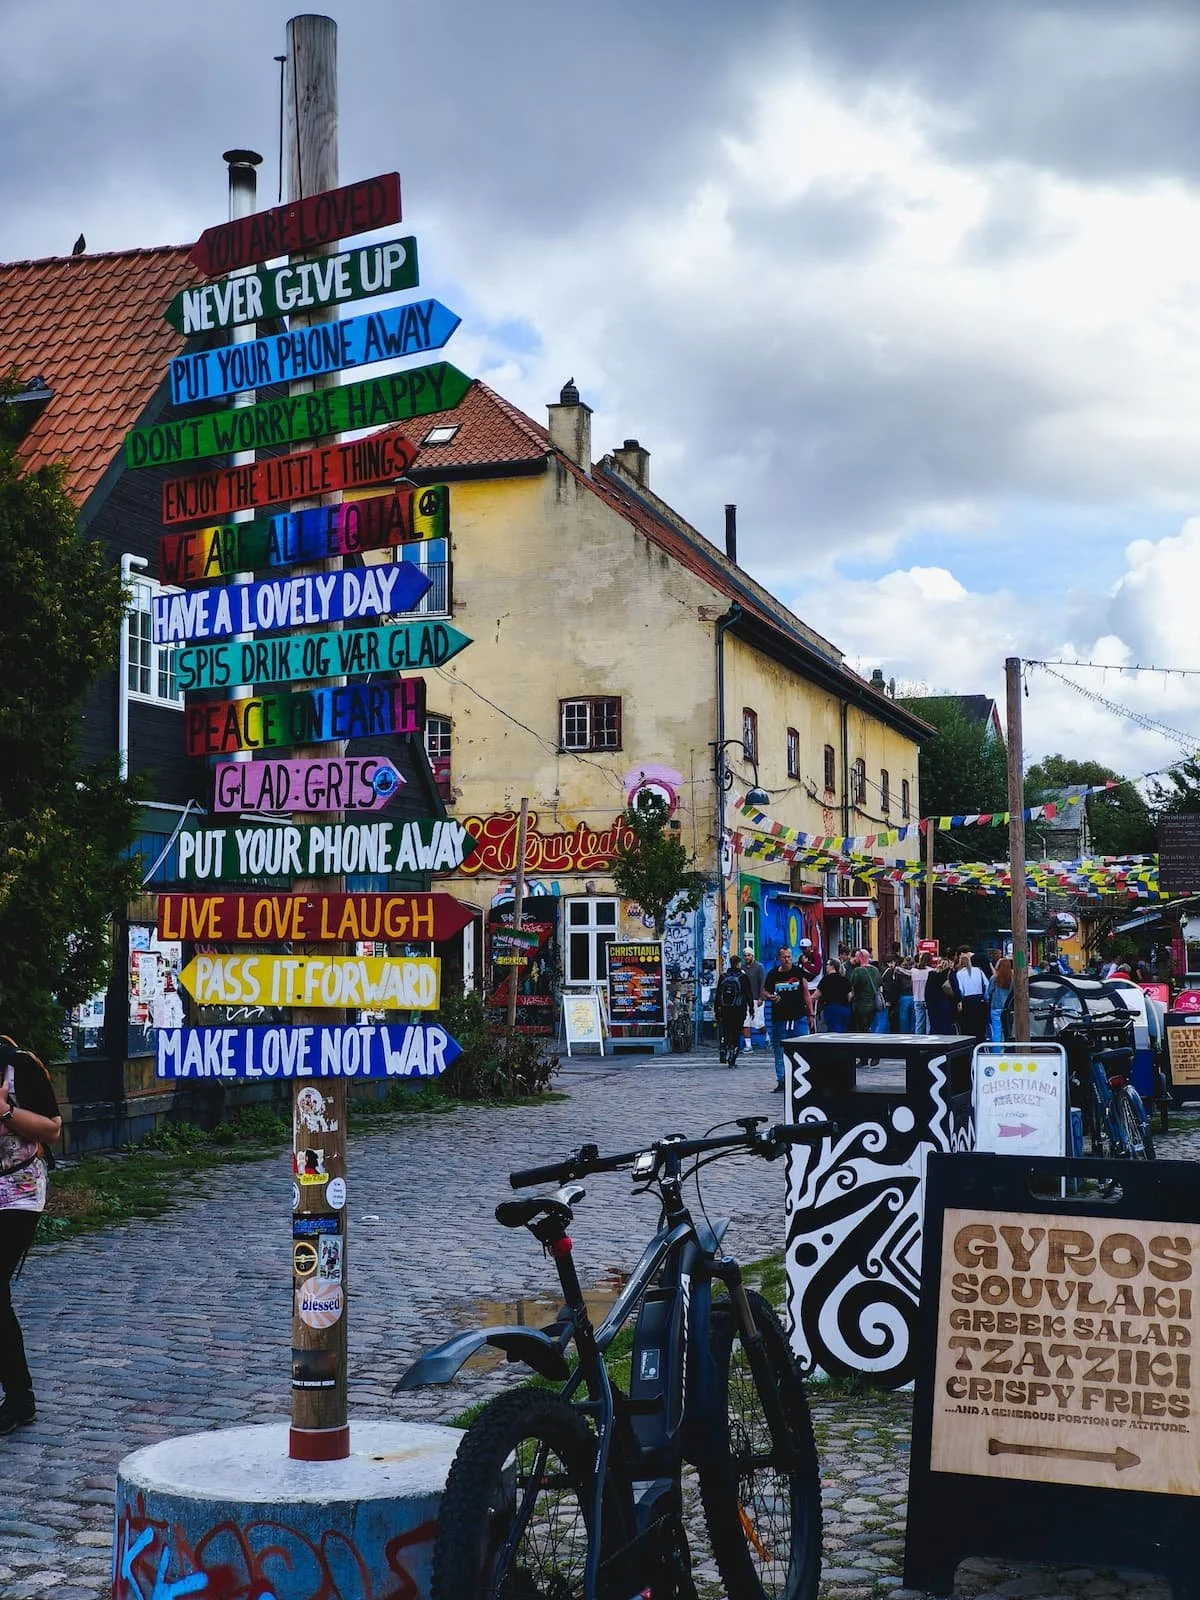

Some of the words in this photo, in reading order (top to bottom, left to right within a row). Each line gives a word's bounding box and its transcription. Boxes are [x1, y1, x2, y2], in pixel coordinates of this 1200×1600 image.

[206, 224, 242, 270] YOU
[250, 209, 292, 258] ARE
[299, 181, 386, 243] LOVED
[183, 275, 264, 335] NEVER
[275, 255, 352, 311] GIVE
[360, 243, 406, 292] UP
[172, 357, 209, 404] PUT
[221, 342, 271, 390] YOUR
[278, 320, 354, 379] PHONE
[364, 299, 435, 361] AWAY
[131, 419, 200, 467] DON'T
[307, 388, 336, 435] BE
[349, 366, 448, 423] HAPPY
[166, 475, 219, 520] ENJOY
[226, 466, 258, 508] THE
[267, 451, 331, 499] LITTLE
[340, 437, 408, 483] THINGS
[163, 534, 196, 580] WE
[204, 525, 246, 576] ARE
[267, 513, 309, 562] ALL
[327, 493, 424, 552] EQUAL
[152, 591, 209, 643] HAVE
[214, 594, 233, 635] A
[241, 575, 337, 633] LOVELY
[343, 567, 400, 616] DAY
[180, 646, 231, 688] SPIS
[242, 641, 291, 683] DRIK
[302, 636, 331, 677] OG
[337, 630, 381, 672] VÆR
[388, 625, 450, 668] GLAD
[189, 699, 277, 753] PEACE
[289, 692, 325, 741] ON
[331, 681, 419, 736] EARTH
[219, 762, 291, 810] GLAD
[304, 761, 379, 810] GRIS
[179, 829, 227, 879] PUT
[235, 824, 303, 875] YOUR
[308, 823, 394, 875] PHONE
[395, 821, 468, 874] AWAY
[162, 896, 225, 939] LIVE
[237, 897, 308, 940] LOVE
[320, 897, 434, 940] LAUGH
[610, 945, 660, 957] CHRISTIANIA
[194, 957, 260, 1004] PASS
[271, 960, 299, 1004] IT
[305, 961, 438, 1008] FORWARD
[157, 1027, 239, 1077] MAKE
[245, 1028, 313, 1077] LOVE
[320, 1027, 376, 1076] NOT
[382, 1026, 449, 1075] WAR
[982, 1078, 1057, 1097] CHRISTIANIA
[953, 1223, 1193, 1283] GYROS
[302, 1294, 340, 1311] Blessed
[949, 1308, 1066, 1338] GREEK
[951, 1273, 1192, 1320] SOUVLAKI
[948, 1336, 1191, 1389] TZATZIKI
[946, 1376, 1075, 1409] CRISPY
[1082, 1386, 1190, 1418] FRIES
[982, 1407, 990, 1416] A
[991, 1409, 1056, 1422] GENEROUS
[1057, 1413, 1109, 1427] PORTION
[1111, 1417, 1128, 1428] OF
